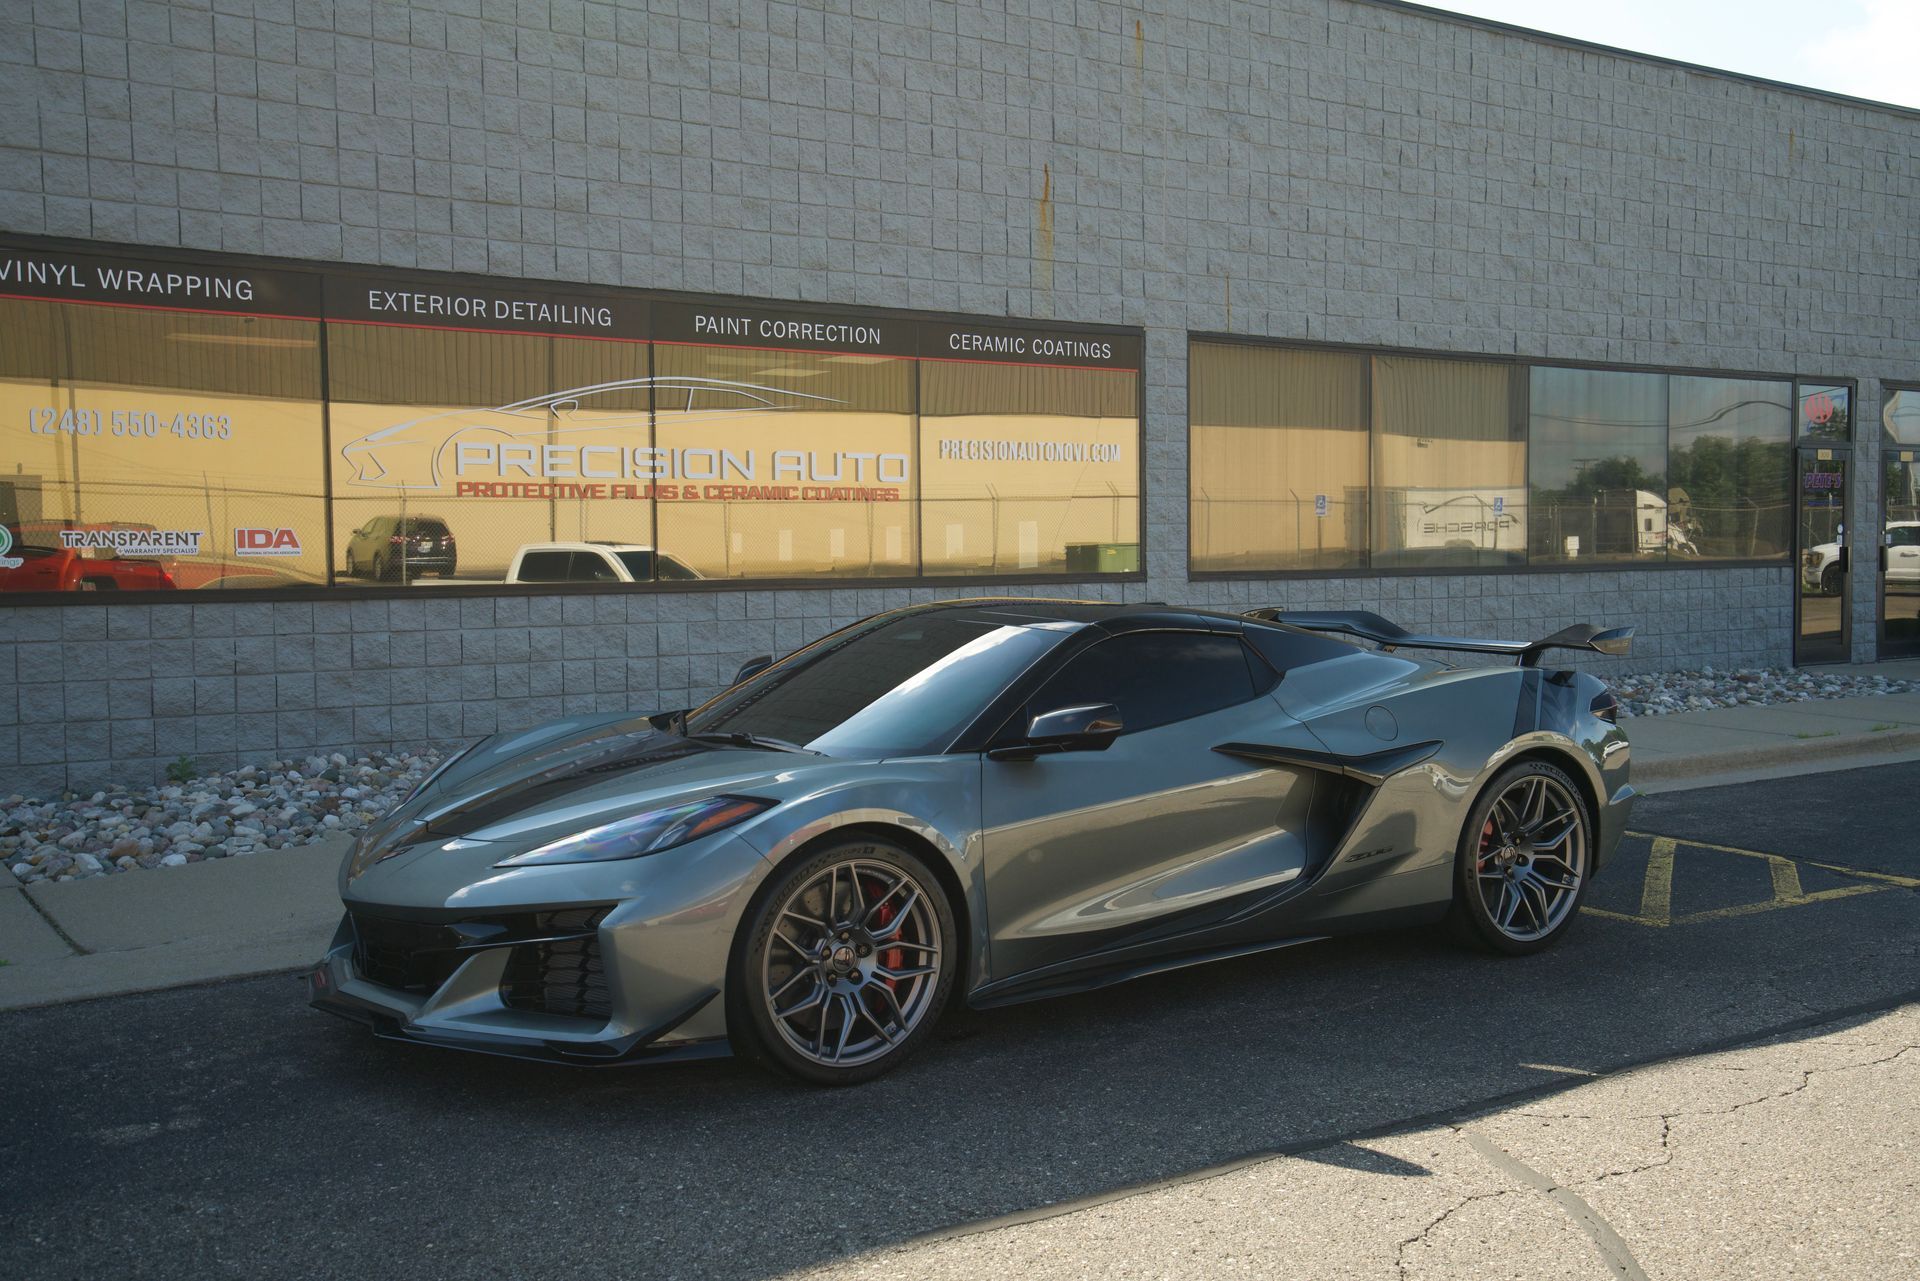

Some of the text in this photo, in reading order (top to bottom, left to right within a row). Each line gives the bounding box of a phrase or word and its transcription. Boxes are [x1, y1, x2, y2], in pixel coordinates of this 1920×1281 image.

[0, 259, 254, 301] VINYL WRAPPING
[368, 290, 613, 327] EXTERIOR DETAILING
[695, 315, 881, 345] PAINT CORRECTION
[949, 333, 1112, 359] CERAMIC COATINGS
[111, 409, 232, 440] 550-4363
[456, 442, 909, 483] PRECISION AUTO
[939, 439, 1121, 463] PRECISIONAUTONOVI.COM
[456, 481, 900, 502] PROTECTIVE FILMS & CERAMIC COATINGS
[61, 532, 200, 547] TRANSPARENT
[237, 529, 300, 549] IDA
